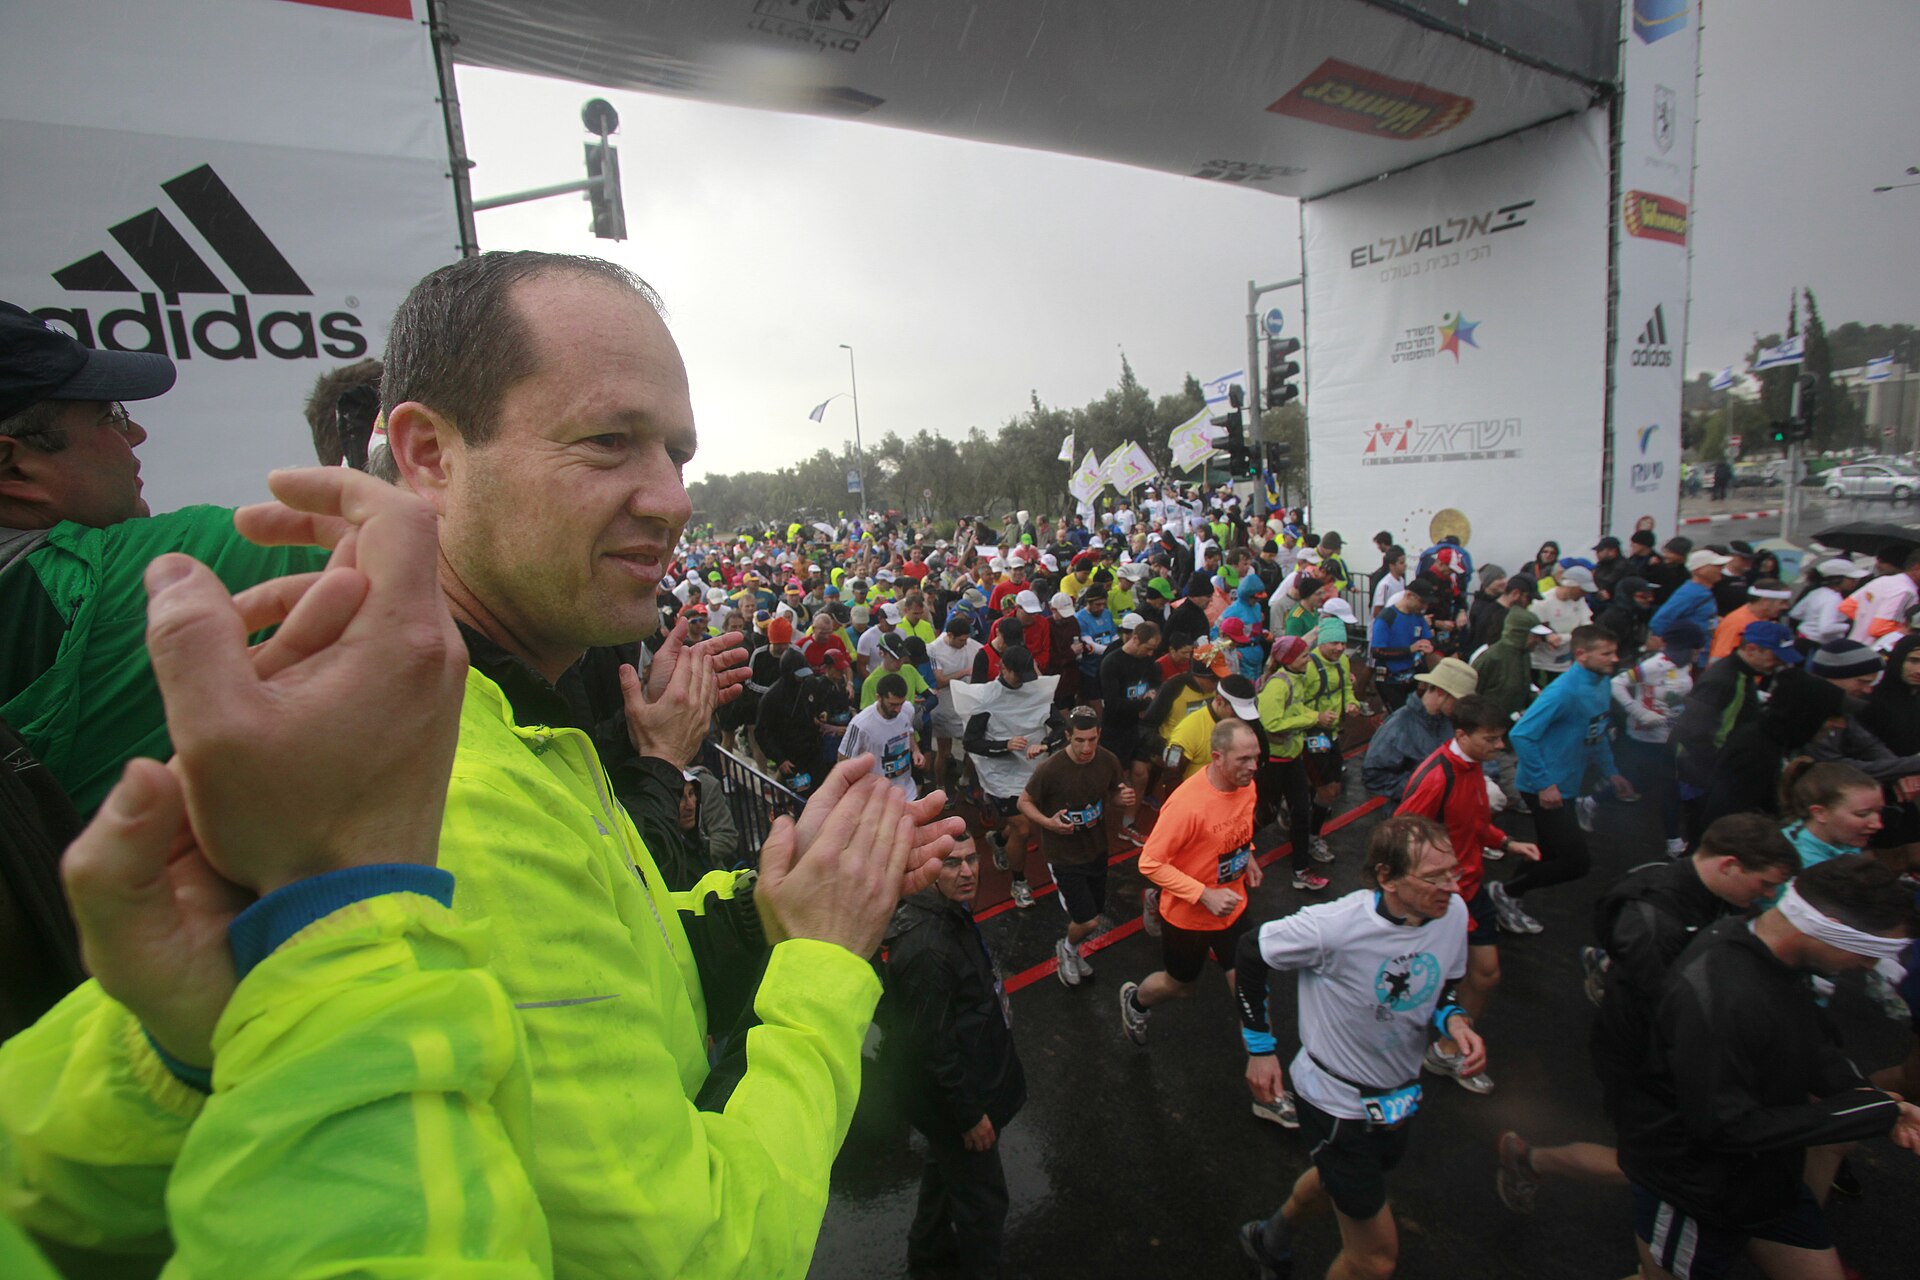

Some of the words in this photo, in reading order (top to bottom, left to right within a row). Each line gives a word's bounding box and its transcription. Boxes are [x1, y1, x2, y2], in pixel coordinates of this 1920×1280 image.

[1301, 81, 1432, 134] Winner
[1466, 245, 1491, 263] הכי
[29, 291, 368, 360] adidas
[1405, 325, 1435, 339] משרד
